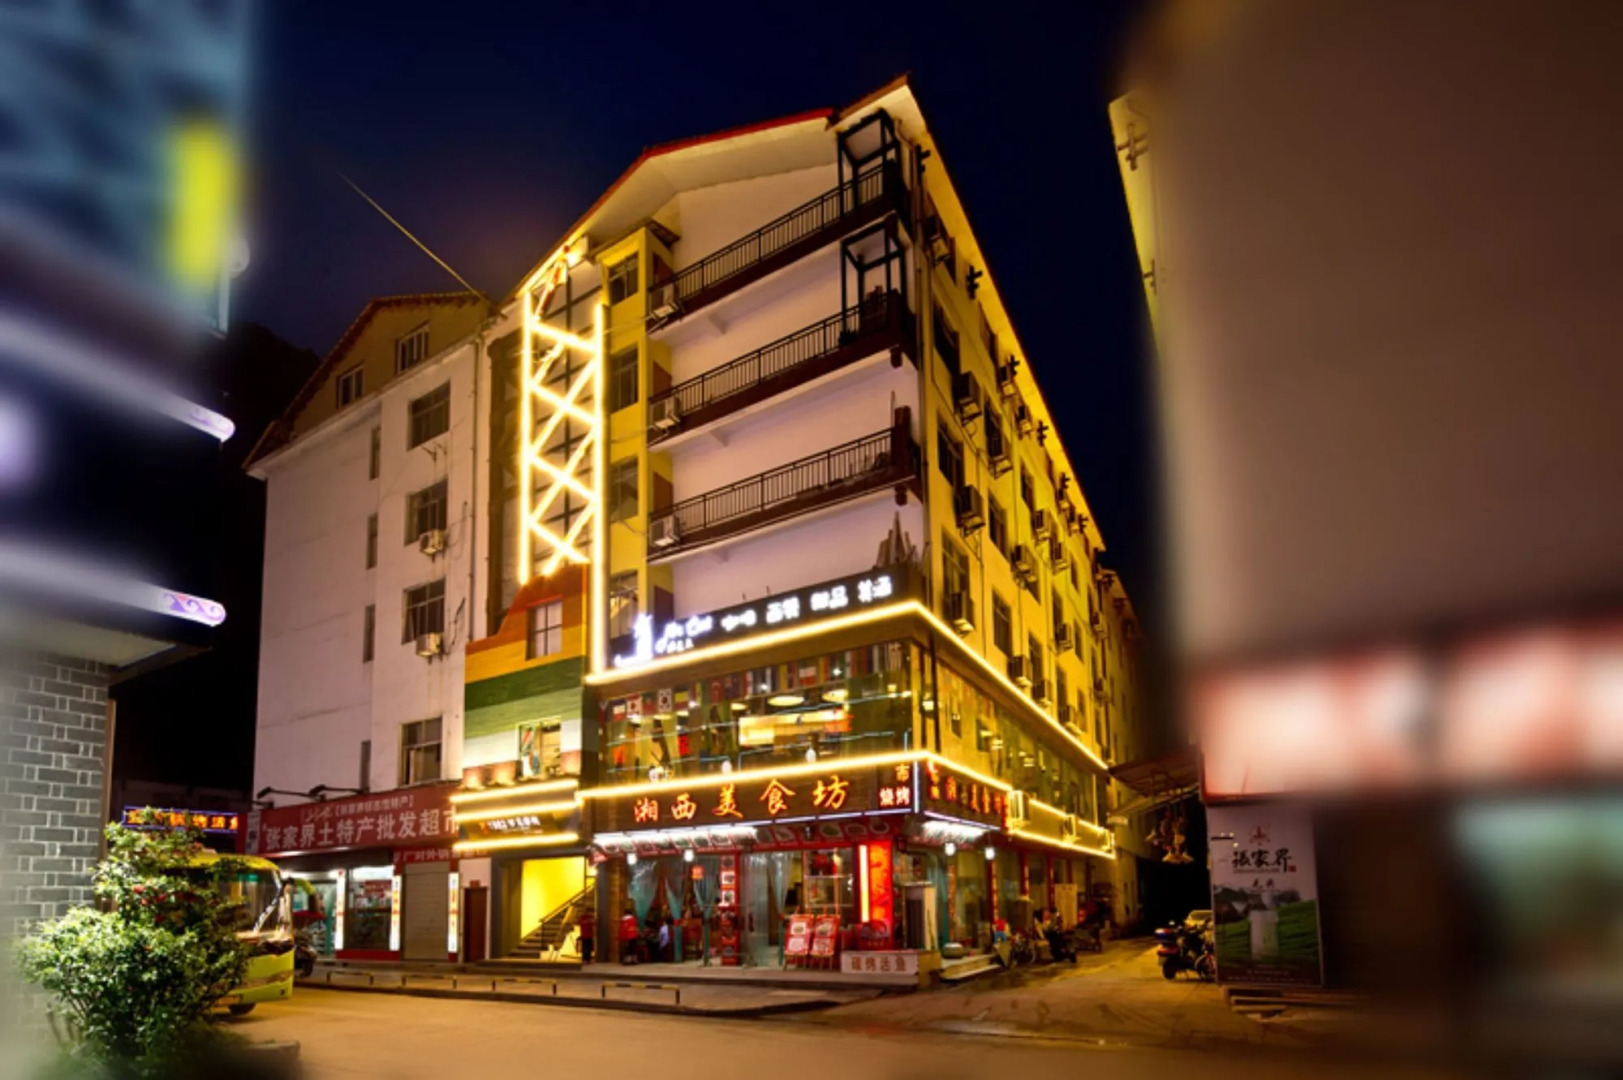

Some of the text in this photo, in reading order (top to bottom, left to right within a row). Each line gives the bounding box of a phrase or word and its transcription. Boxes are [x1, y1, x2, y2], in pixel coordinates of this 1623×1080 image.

[634, 775, 849, 822] 湘西美食坊
[265, 806, 461, 851] 张家界土特产批发超市
